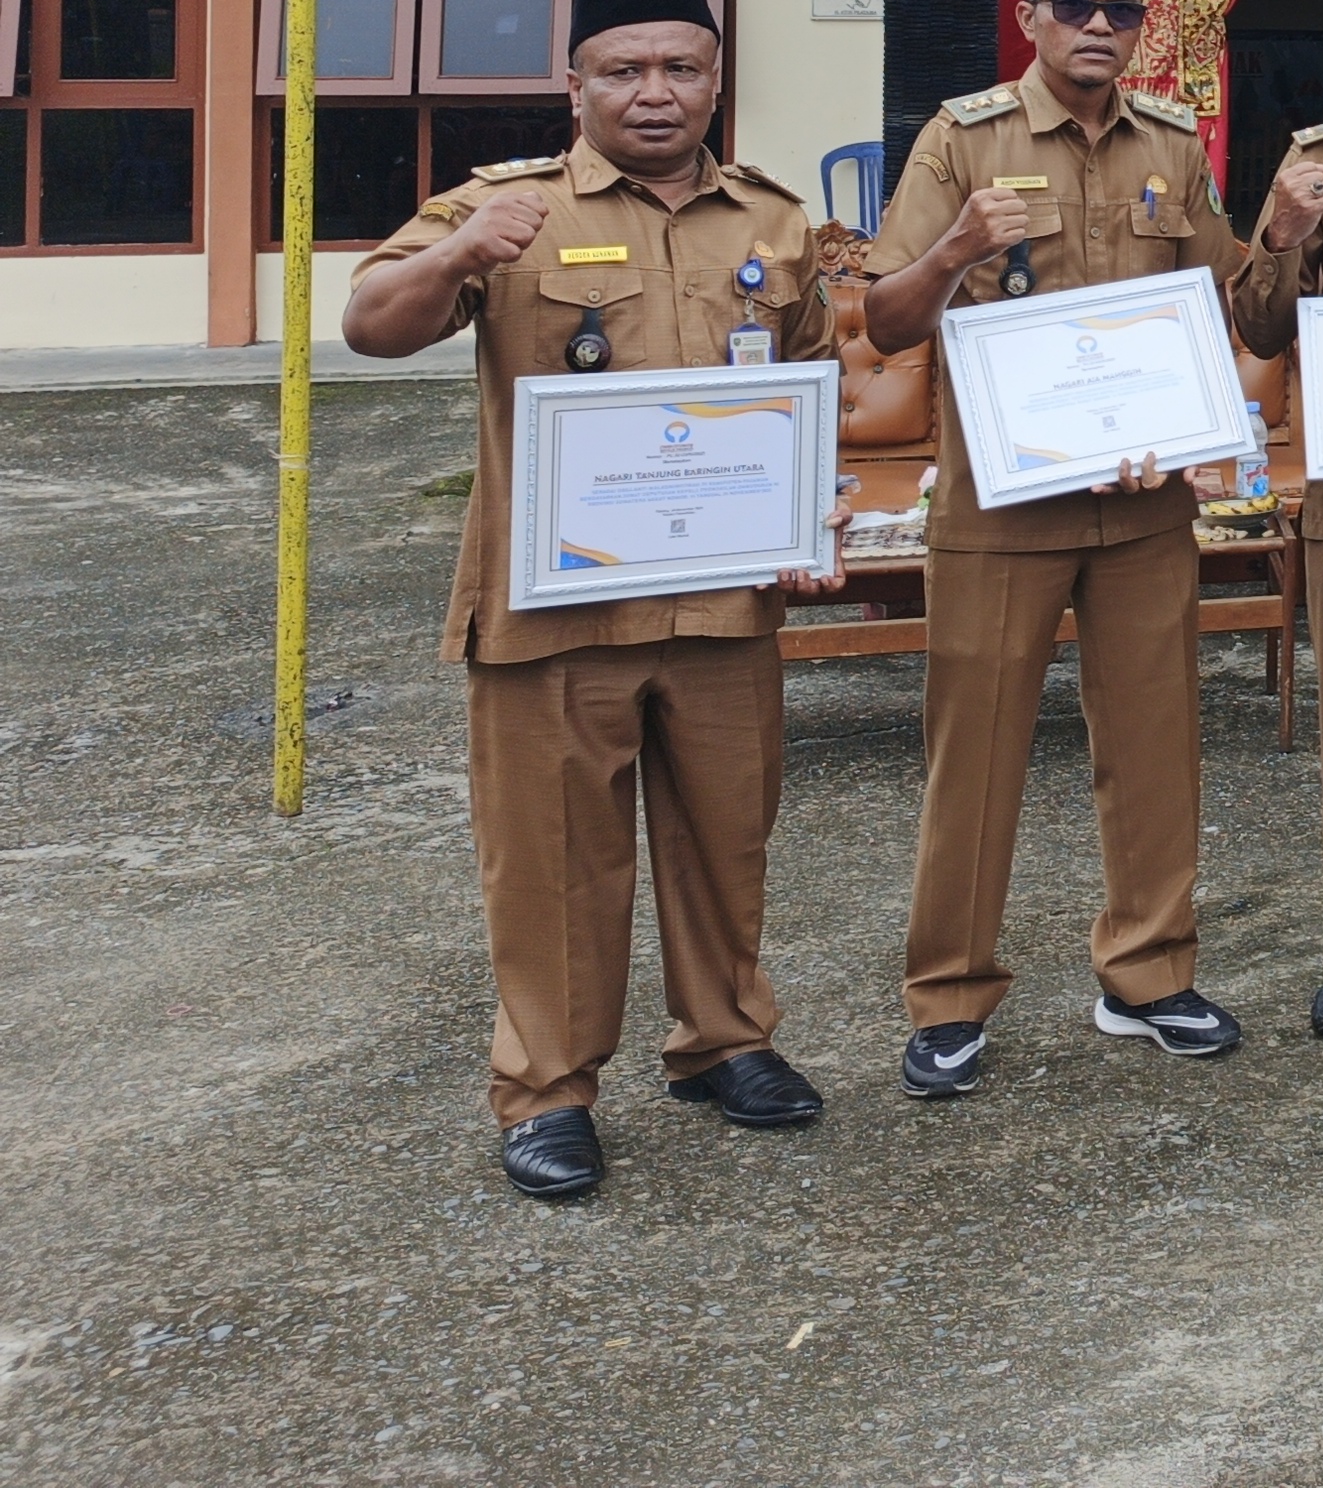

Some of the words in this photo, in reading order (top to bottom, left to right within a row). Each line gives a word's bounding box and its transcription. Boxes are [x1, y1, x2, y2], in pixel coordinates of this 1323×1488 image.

[594, 473, 632, 483] NAGARI
[635, 469, 681, 480] TANJUNG
[733, 463, 765, 473] UTARA
